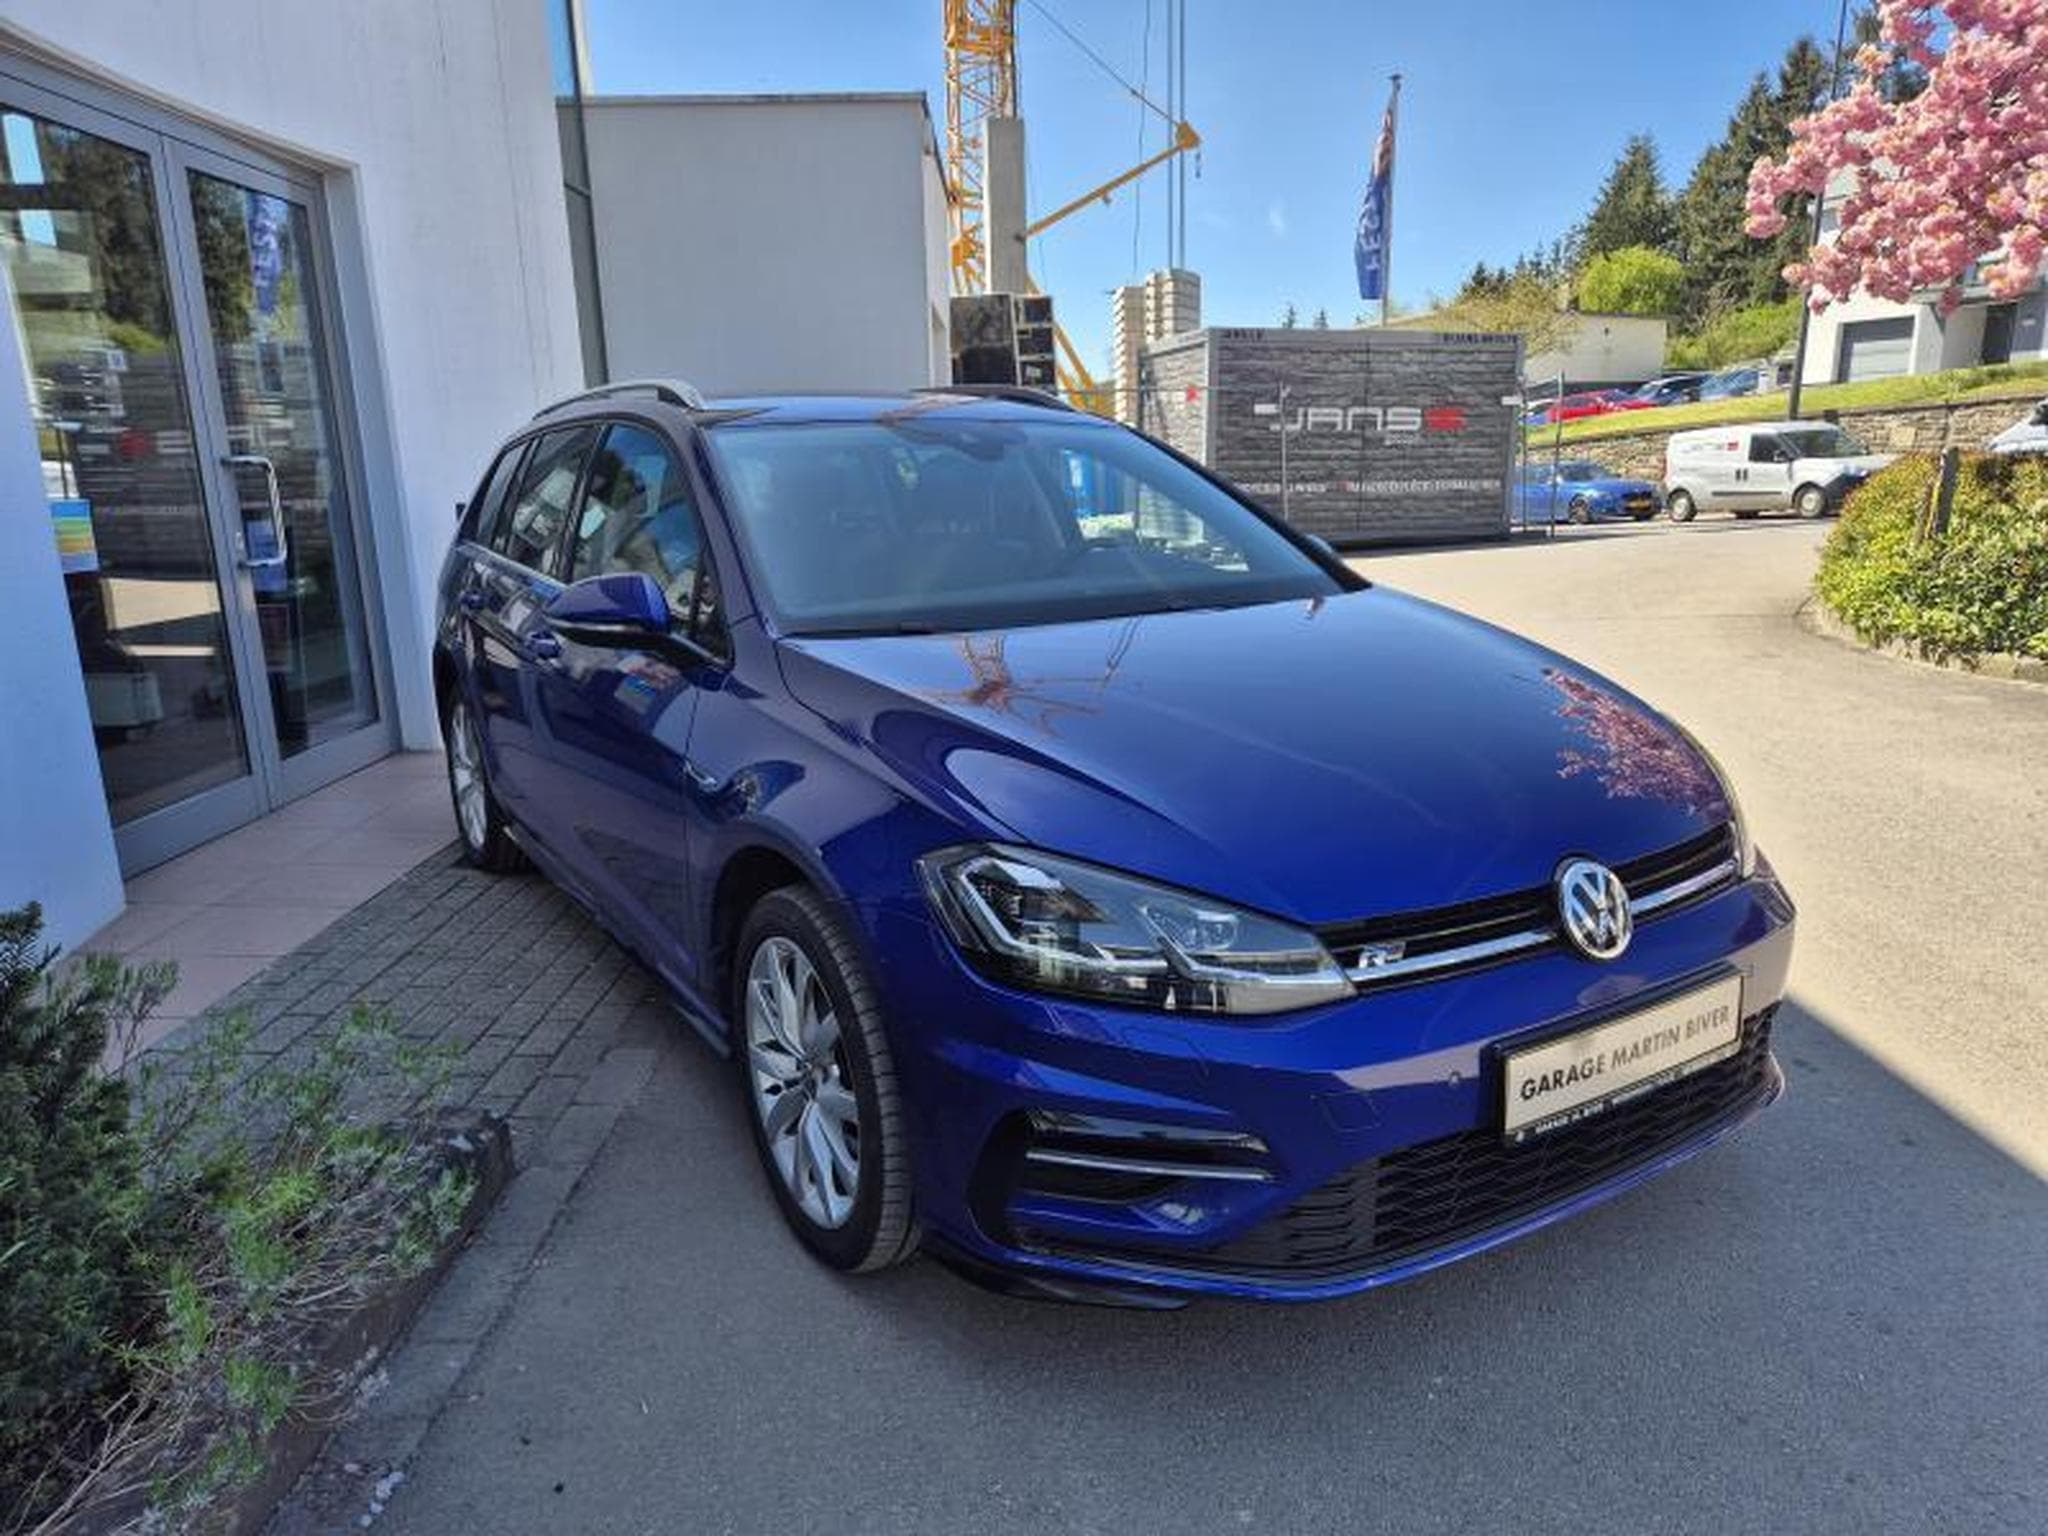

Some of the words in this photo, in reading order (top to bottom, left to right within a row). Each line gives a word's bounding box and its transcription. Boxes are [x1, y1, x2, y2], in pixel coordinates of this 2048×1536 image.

[1520, 1055, 1605, 1101] GARAGE
[1611, 1025, 1681, 1070] MARTIN
[1686, 1005, 1731, 1042] BIVER
